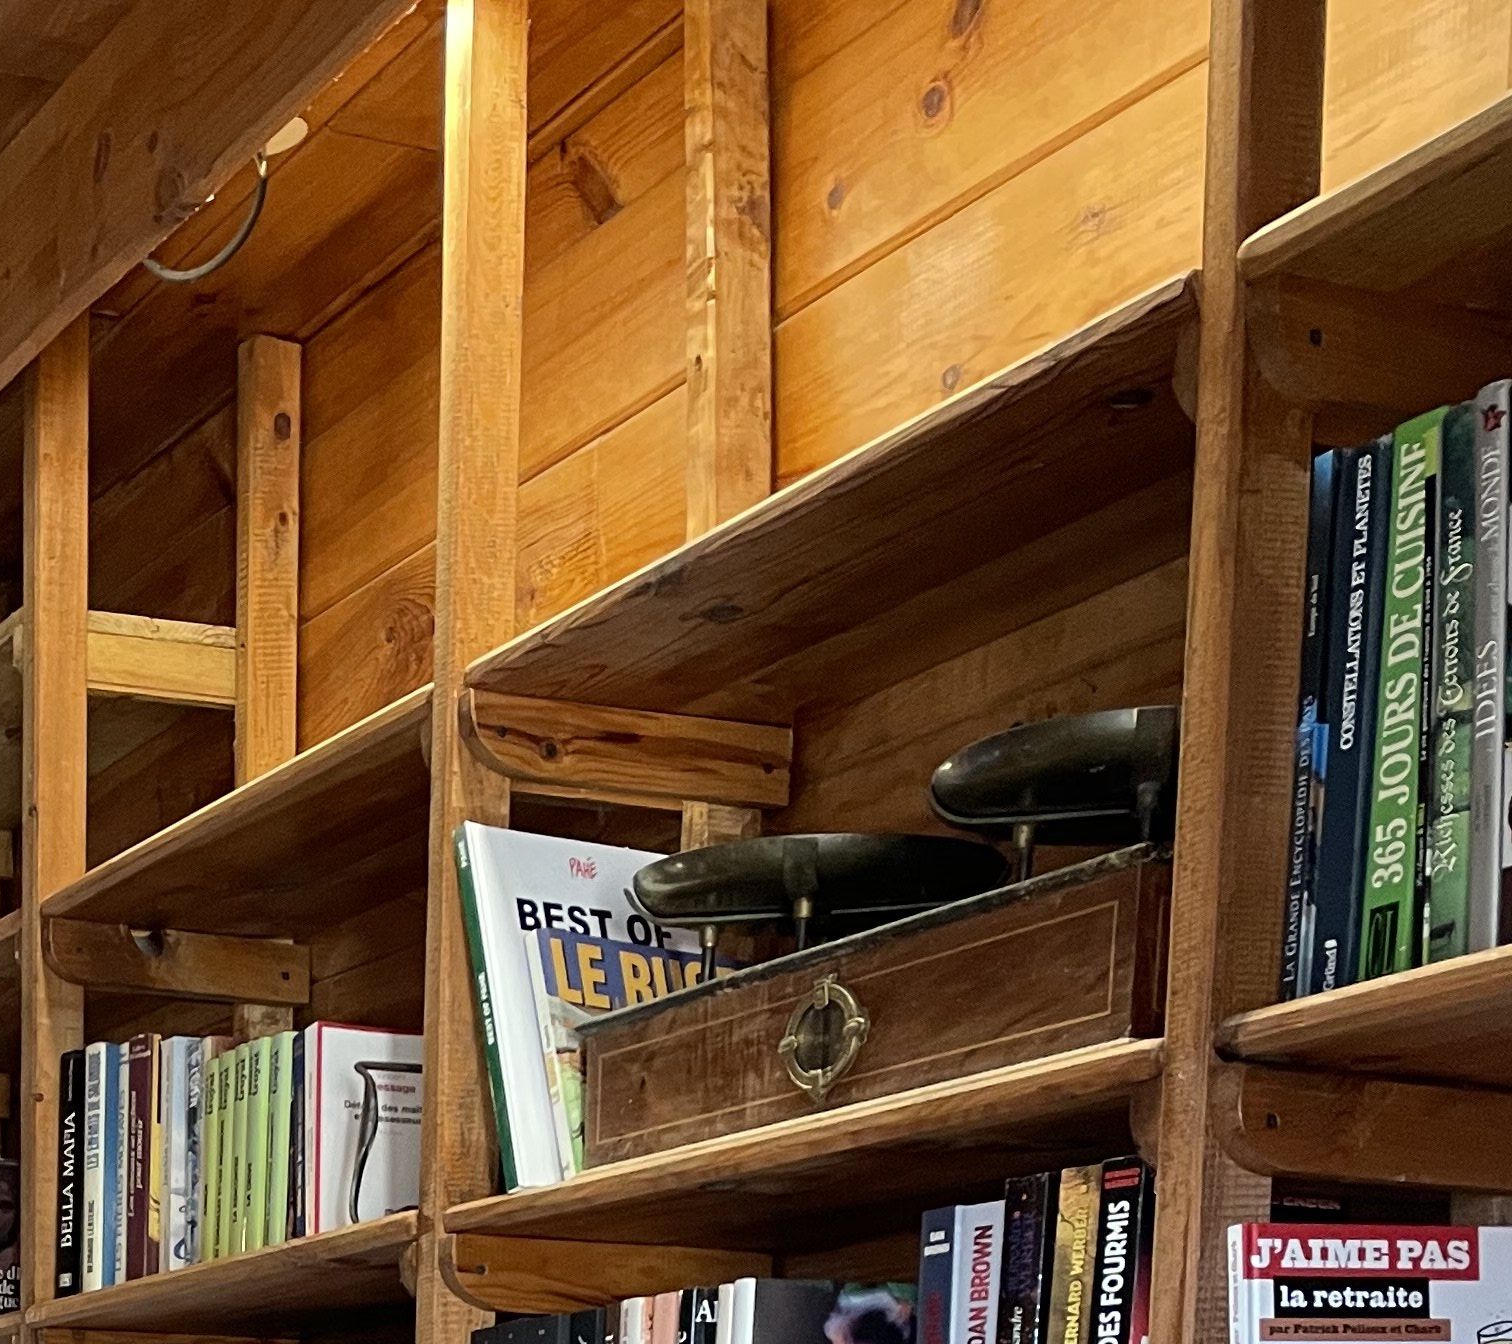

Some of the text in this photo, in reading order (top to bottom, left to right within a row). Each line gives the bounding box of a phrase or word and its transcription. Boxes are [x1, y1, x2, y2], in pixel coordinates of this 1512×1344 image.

[1350, 559, 1365, 586] ET
[1441, 586, 1458, 611] de
[1388, 606, 1420, 666] DE
[1339, 591, 1363, 751] CONSTELLATIONS
[1377, 670, 1417, 805] JOURS
[1439, 718, 1456, 750] des
[1431, 753, 1457, 885] Richesses
[1372, 816, 1405, 889] 365
[516, 897, 672, 950] BEST OF
[1286, 893, 1301, 956] GRANDE
[550, 938, 611, 1010] LE
[61, 1183, 74, 1248] BELLA
[1070, 1206, 1090, 1276] WERBER
[970, 1225, 992, 1301] BROWN
[1100, 1200, 1129, 1306] FOURMIS
[1250, 1238, 1470, 1270] J'AIME PAS
[1280, 1285, 1423, 1309] la retraite
